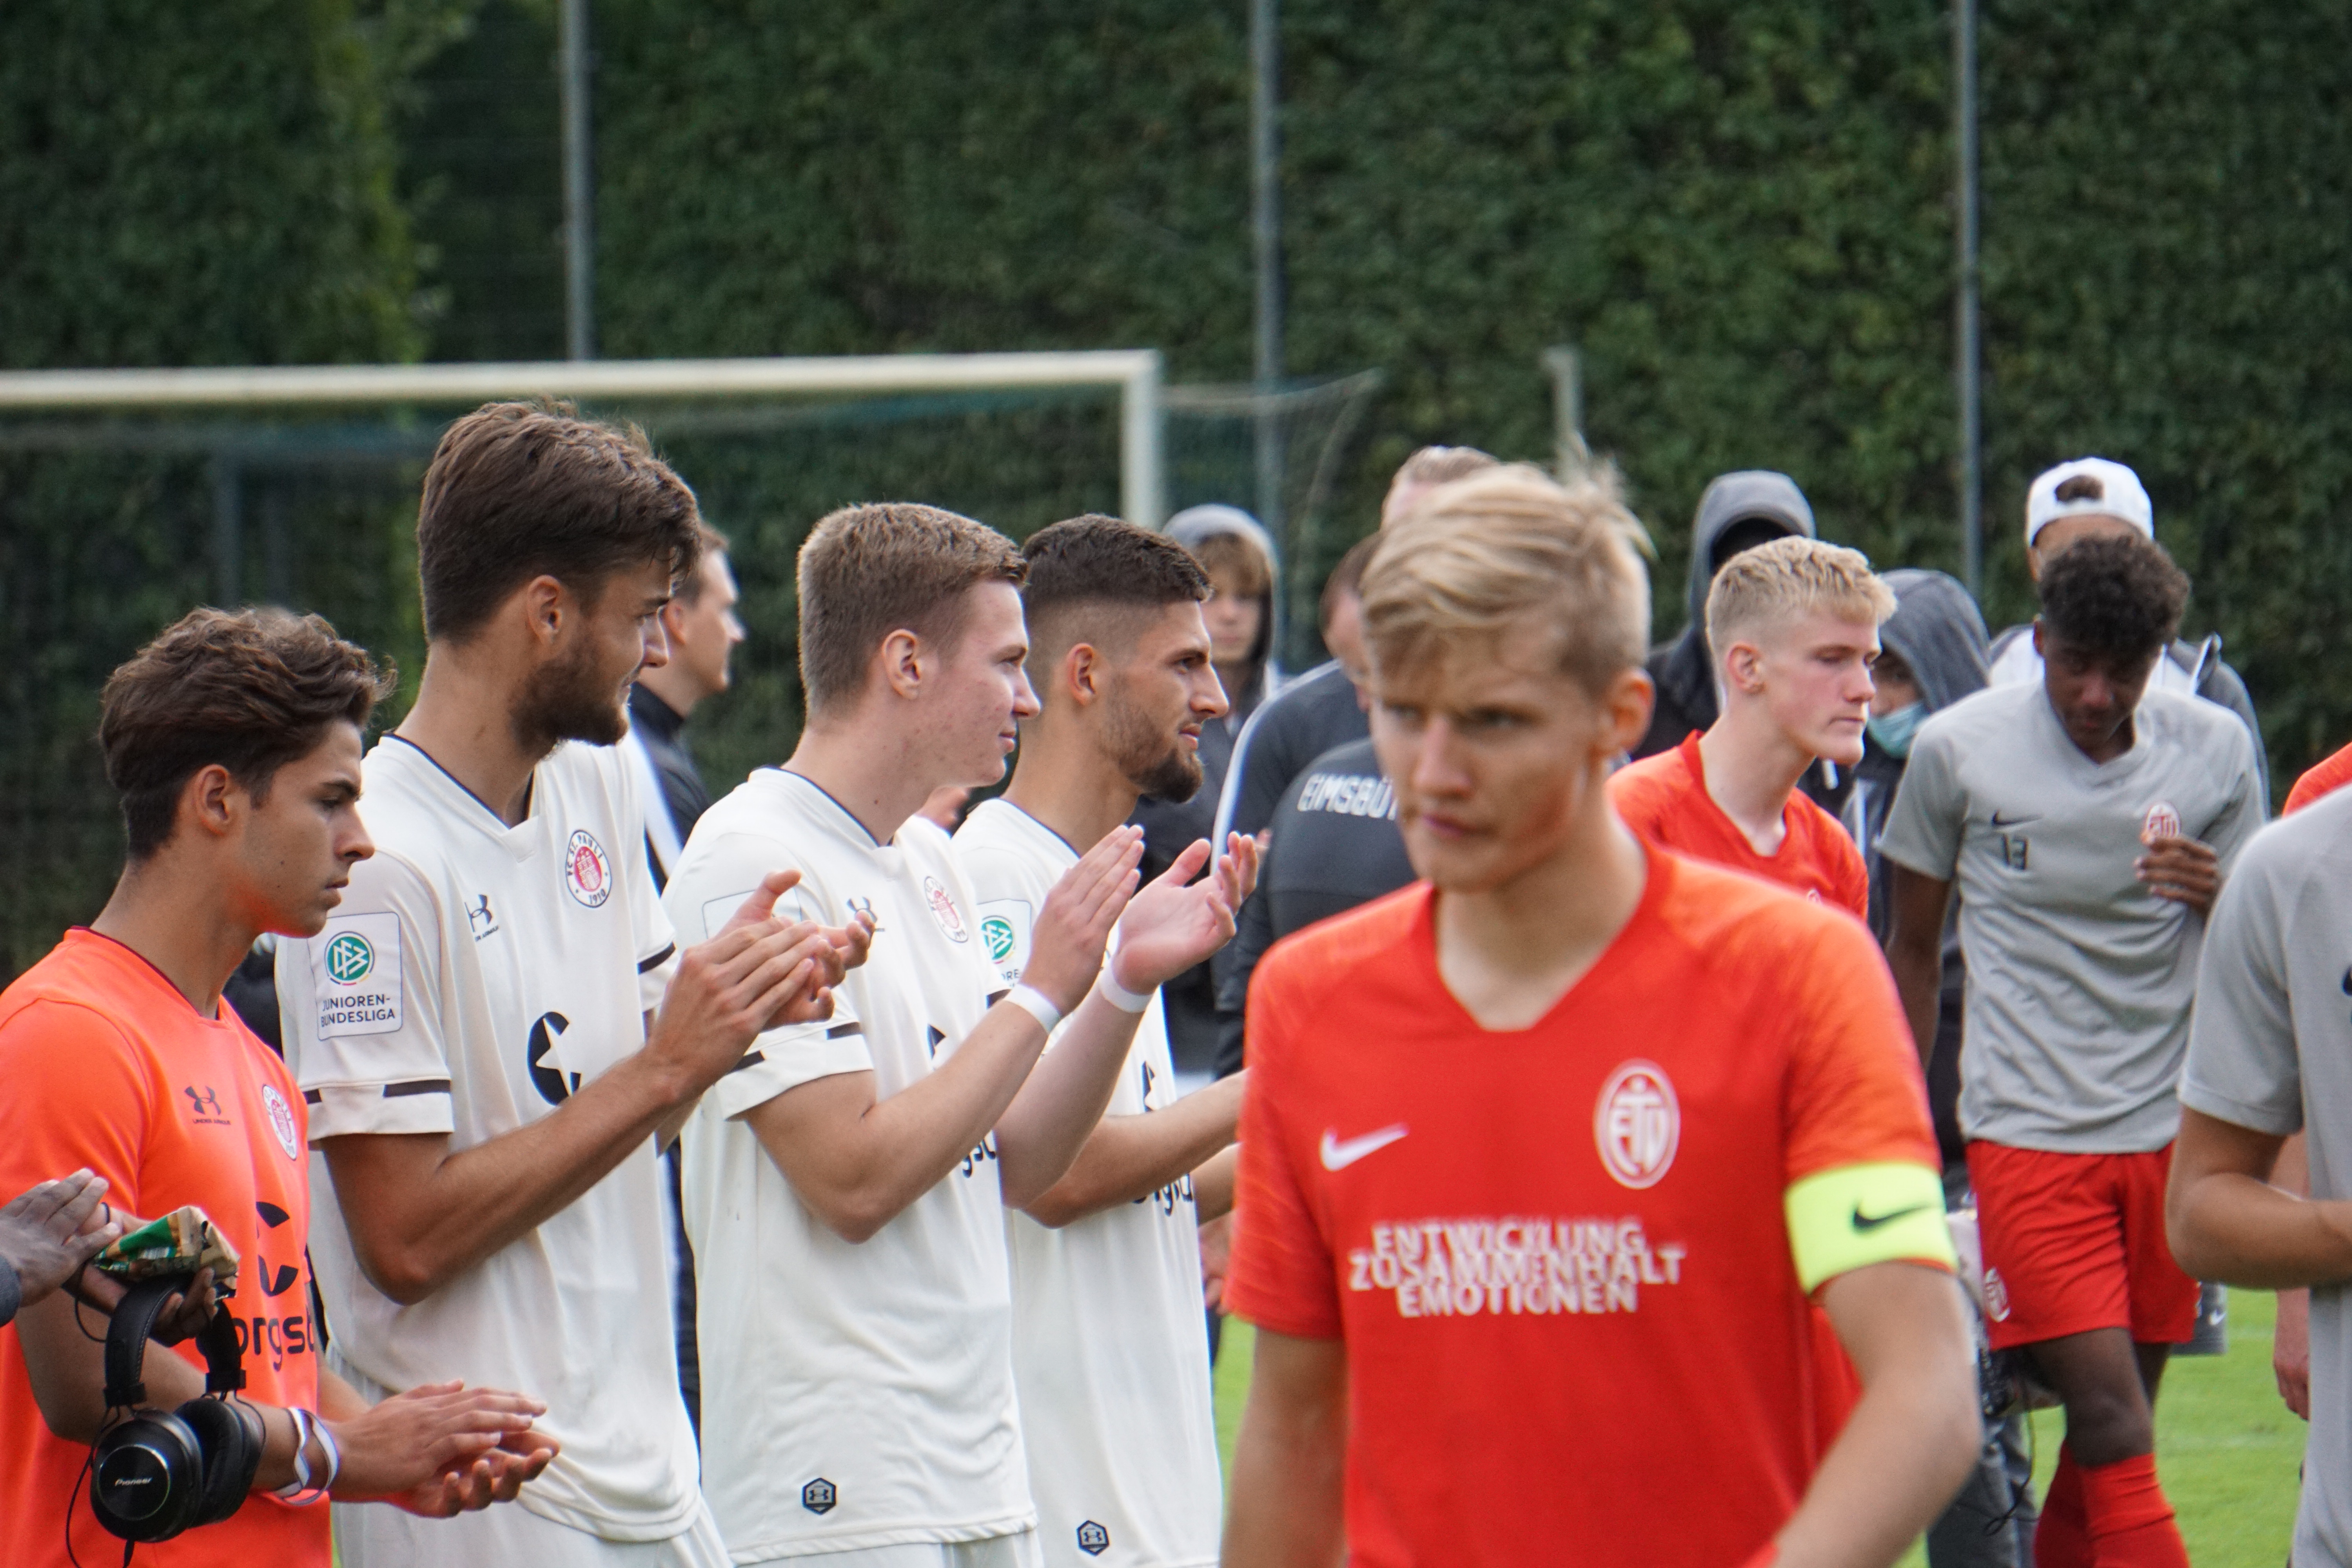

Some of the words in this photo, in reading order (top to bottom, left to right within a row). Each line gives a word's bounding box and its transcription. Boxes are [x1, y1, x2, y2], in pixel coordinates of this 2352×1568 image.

[588, 888, 606, 904] 1910
[323, 994, 391, 1012] JUNIOREN-
[321, 1008, 396, 1028] BUNDESLIGA
[1371, 1217, 1647, 1256] ENTWICKLUNG
[1348, 1246, 1687, 1291] ZUSAMMENHALT
[1396, 1282, 1638, 1318] EMOTIONEN
[114, 1477, 153, 1486] Pioneer
